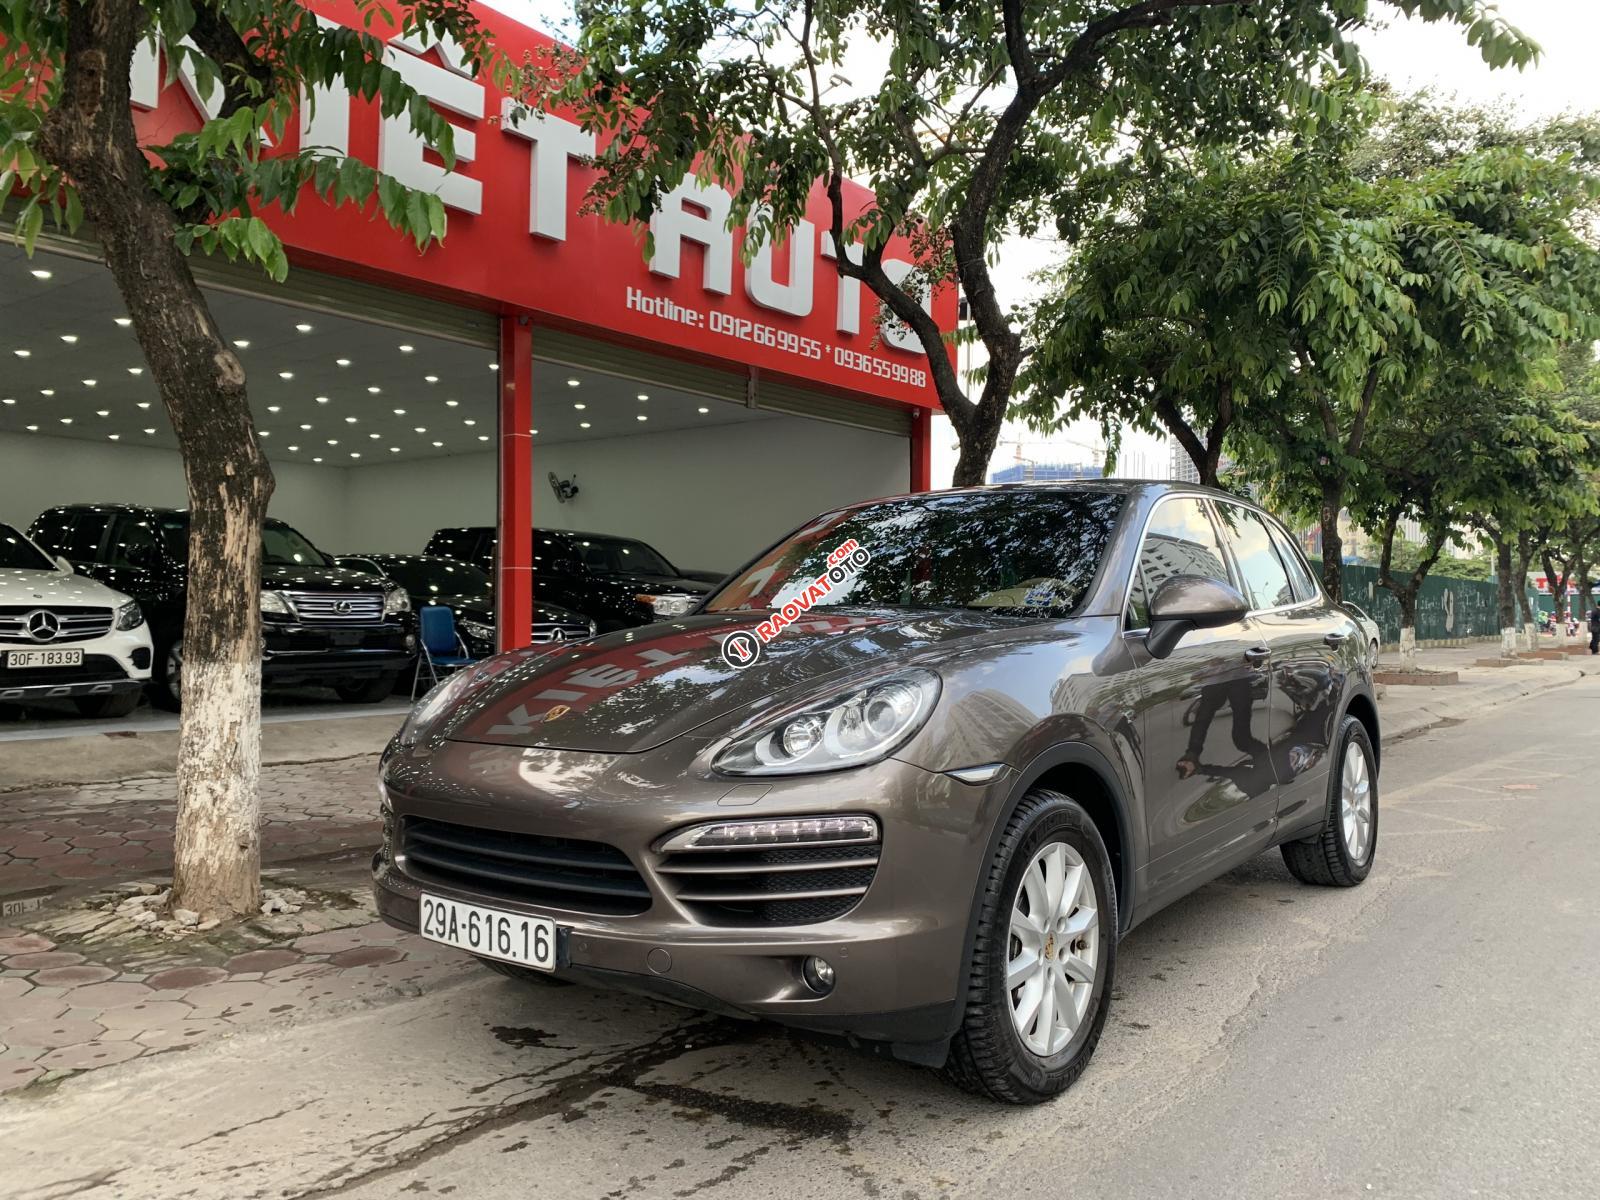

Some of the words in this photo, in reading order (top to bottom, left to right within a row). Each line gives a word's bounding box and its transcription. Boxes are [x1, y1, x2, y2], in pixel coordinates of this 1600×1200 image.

[626, 286, 705, 328] Hotline:
[709, 310, 822, 361] 0912669955
[834, 347, 926, 388] 0936559988
[10, 651, 80, 666] 30F-183.93
[423, 899, 549, 963] 29A-616.16
